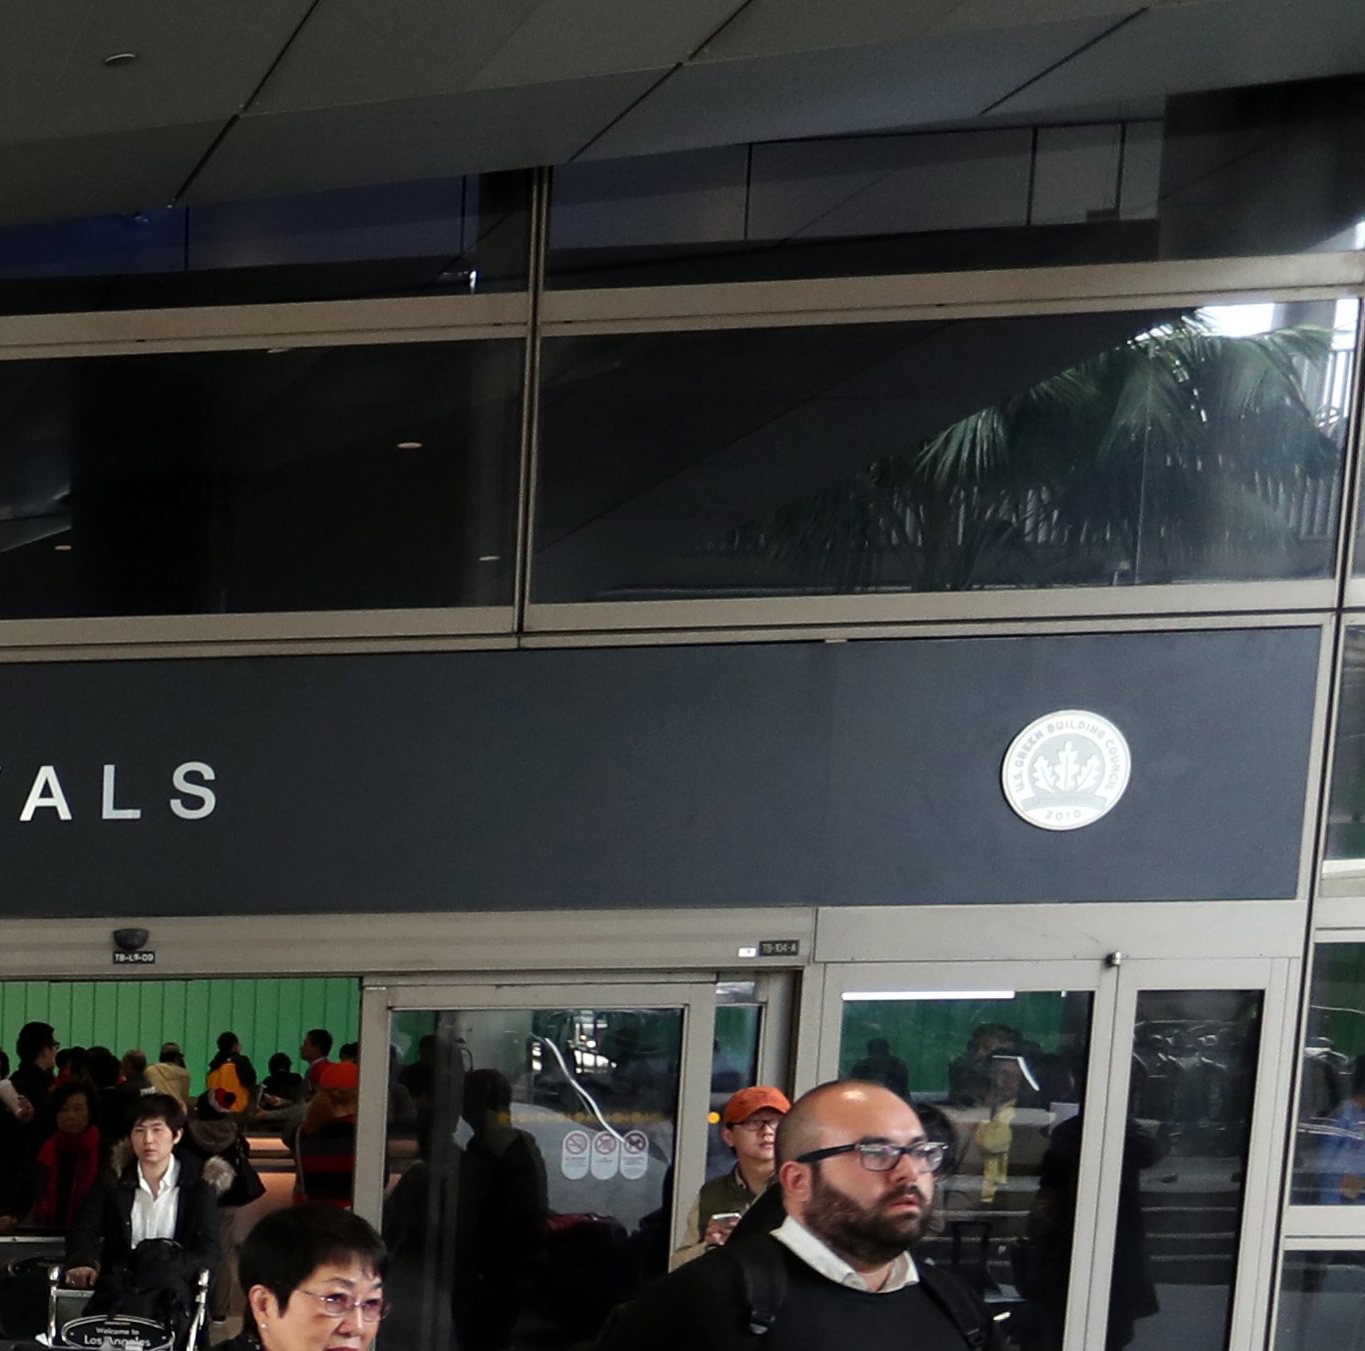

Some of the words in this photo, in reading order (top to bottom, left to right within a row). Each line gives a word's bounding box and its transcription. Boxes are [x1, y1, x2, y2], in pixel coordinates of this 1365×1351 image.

[1015, 730, 1045, 769] GREEN
[1046, 720, 1105, 740] BUILDING
[1104, 737, 1122, 791] COUNCIL
[84, 1334, 102, 1345] Los
